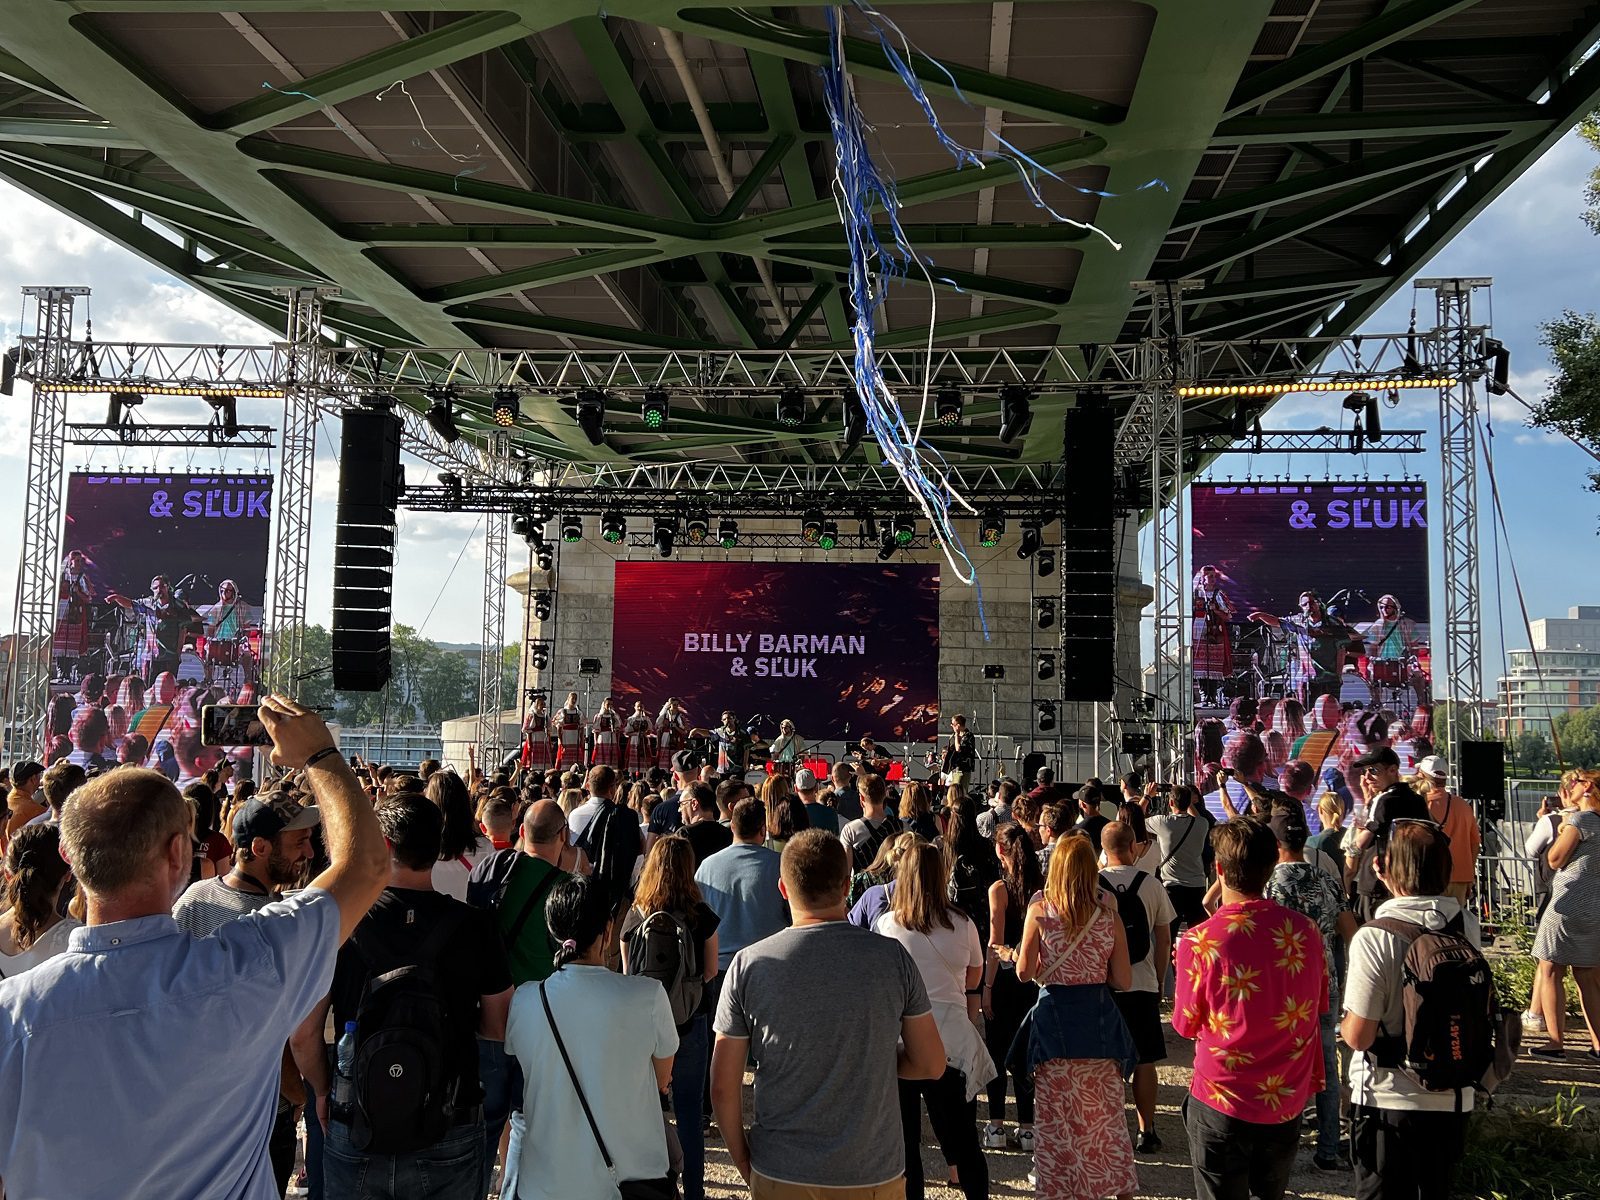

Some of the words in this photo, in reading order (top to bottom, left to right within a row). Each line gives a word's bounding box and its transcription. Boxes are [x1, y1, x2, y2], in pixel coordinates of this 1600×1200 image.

[149, 490, 173, 518] &
[1289, 500, 1317, 529] &
[684, 633, 752, 653] BILLY
[759, 634, 865, 655] BARMAN
[730, 656, 748, 677] &
